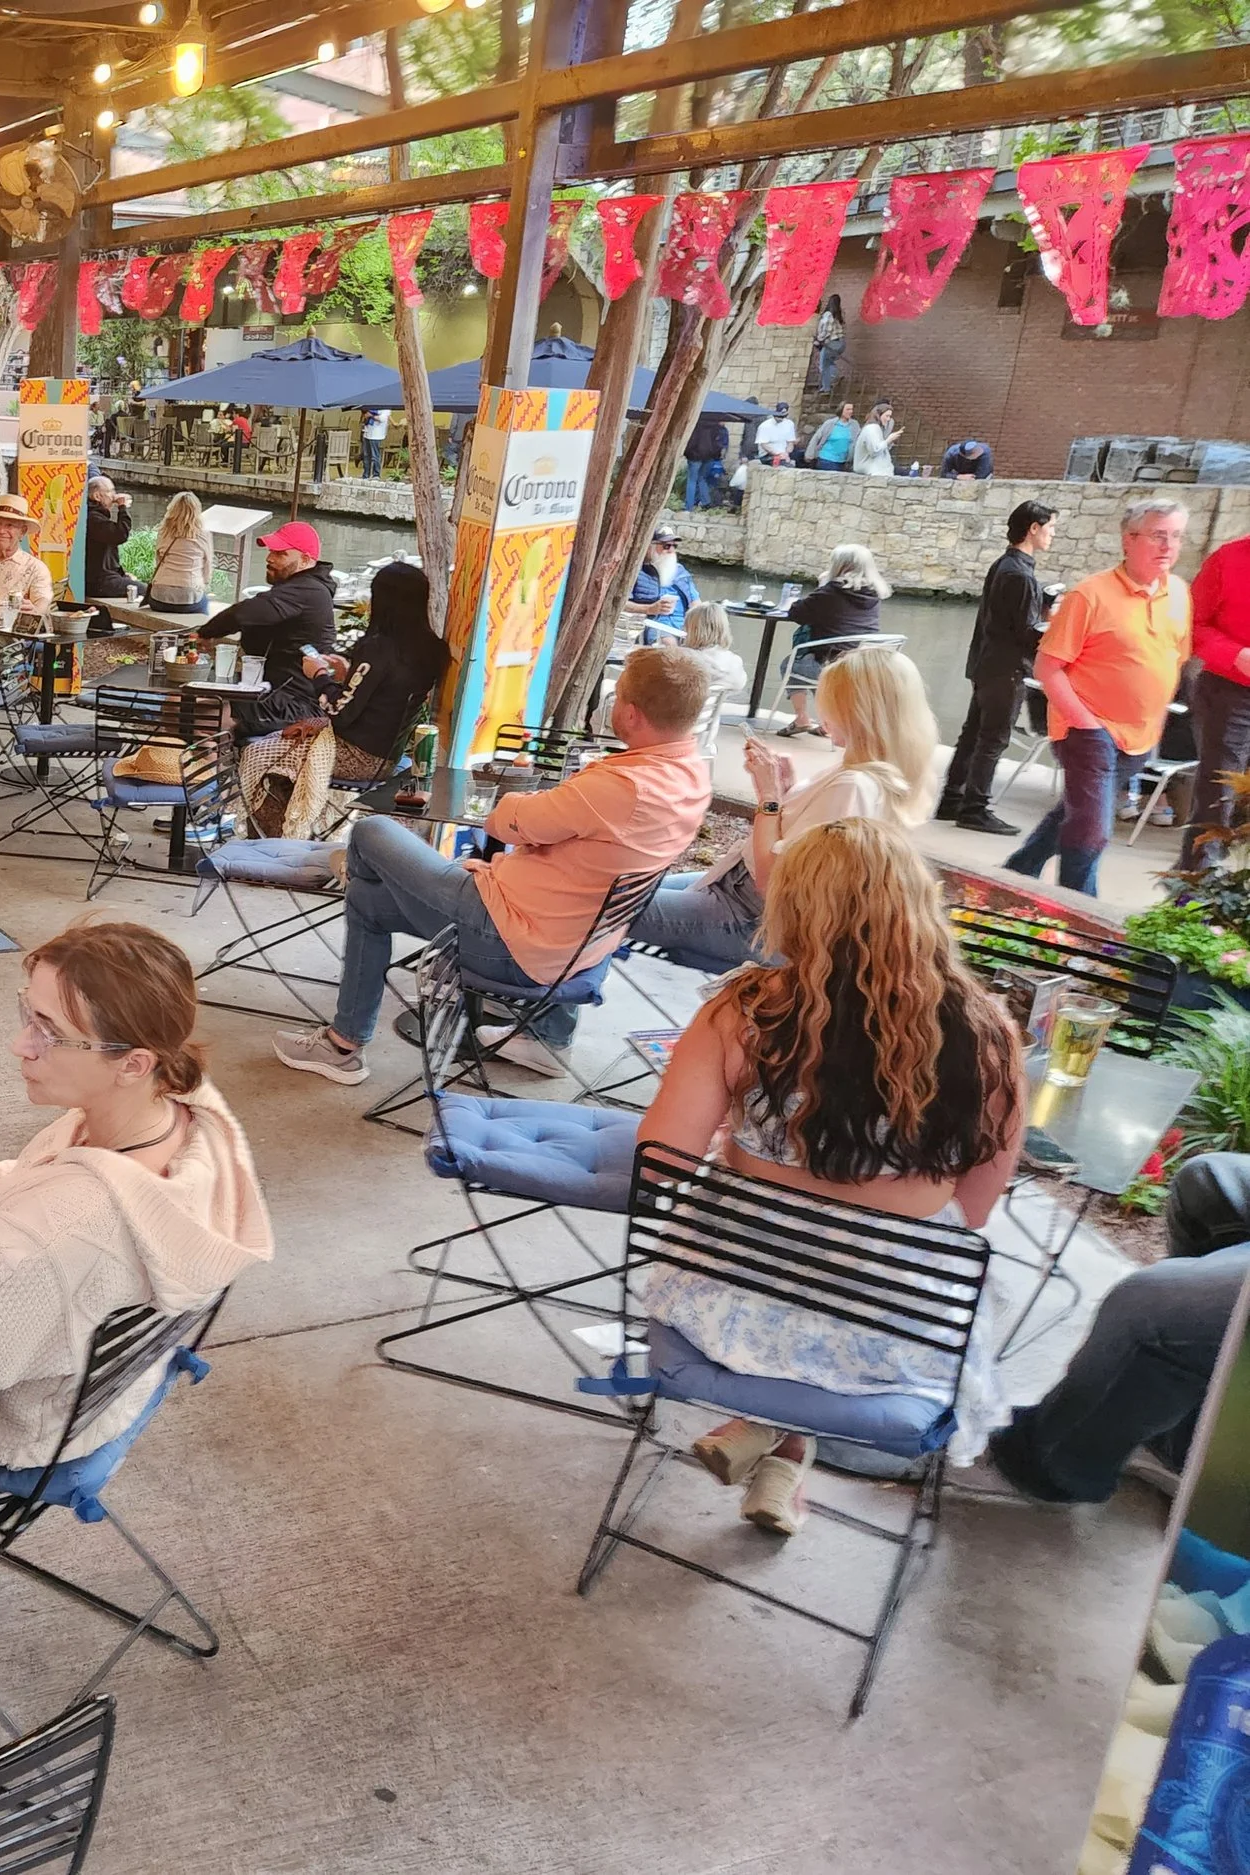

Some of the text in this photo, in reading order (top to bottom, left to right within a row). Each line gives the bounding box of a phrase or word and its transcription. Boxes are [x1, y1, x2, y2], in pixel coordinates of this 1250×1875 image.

[21, 429, 83, 451] Corona
[467, 464, 496, 500] Corona
[504, 473, 577, 510] Corona
